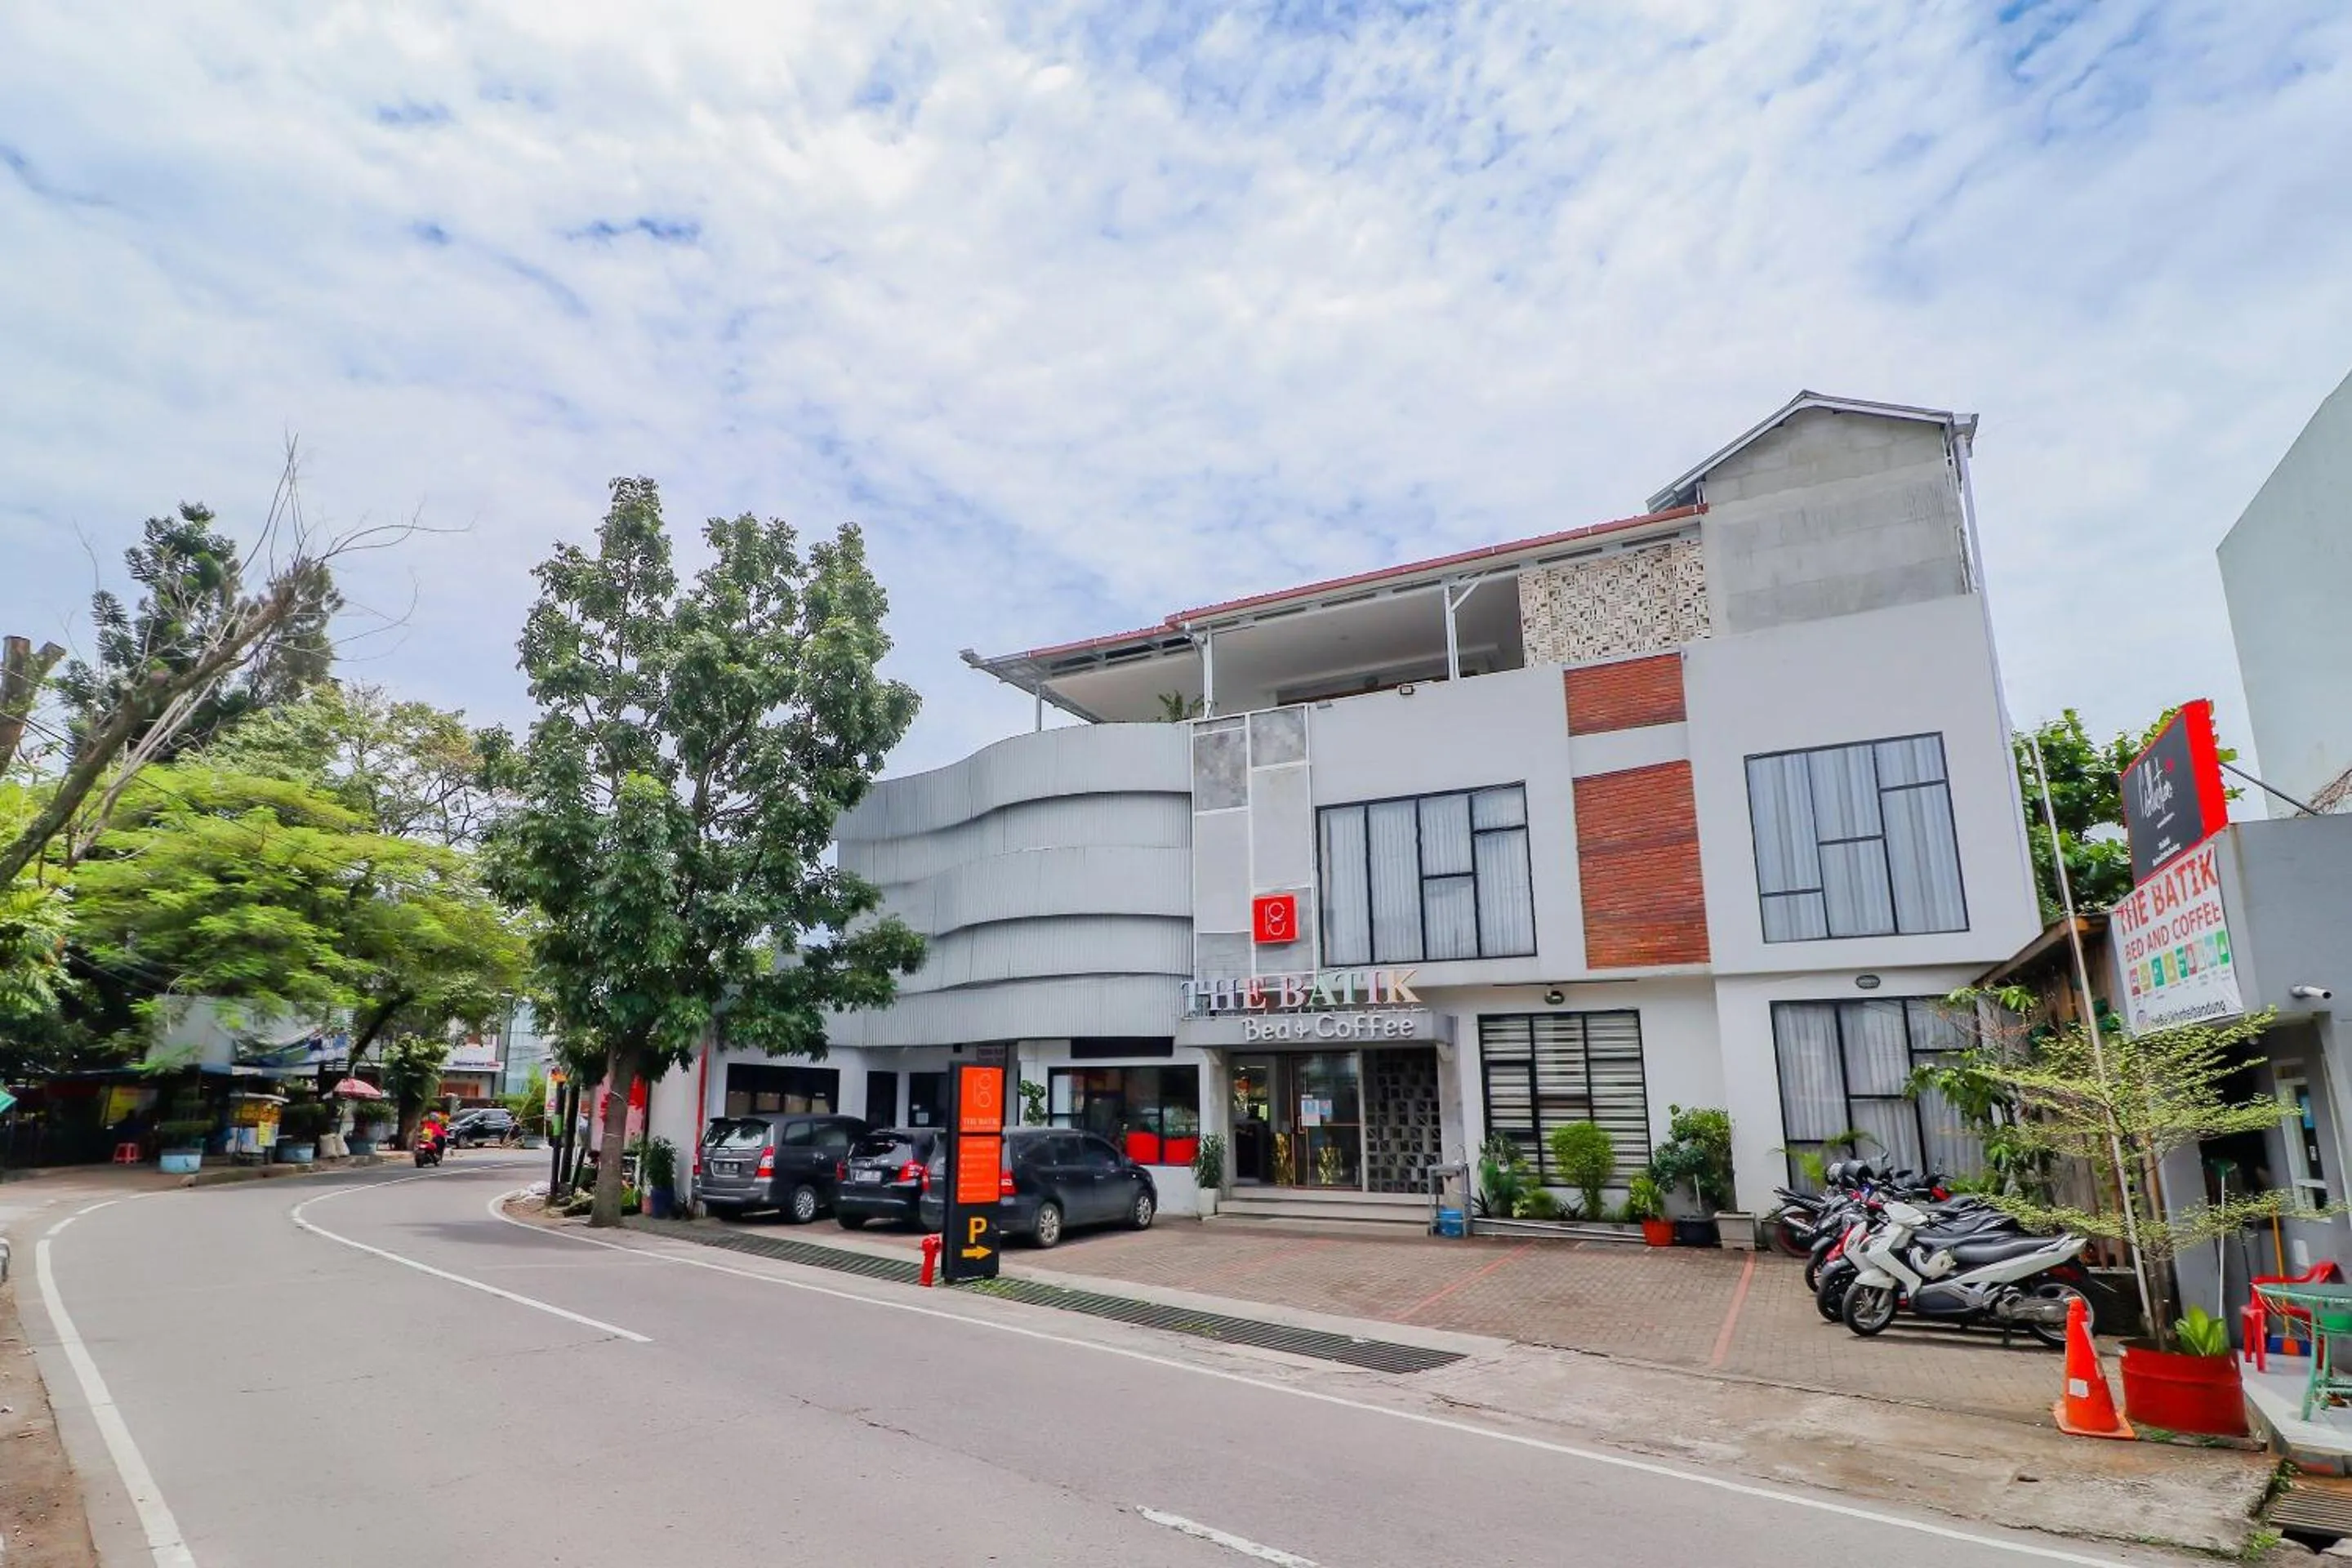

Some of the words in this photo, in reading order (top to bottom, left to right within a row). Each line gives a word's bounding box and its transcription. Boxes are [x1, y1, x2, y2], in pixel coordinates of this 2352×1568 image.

[2114, 889, 2149, 935] THE
[2151, 848, 2218, 916] BATIK
[2125, 938, 2145, 962] BED
[2147, 924, 2169, 953] AND
[2172, 901, 2221, 940] COFFEE
[1181, 978, 1267, 1012] THE
[1276, 969, 1422, 1009] BATIK
[1242, 1018, 1290, 1042] Bed
[1294, 1019, 1311, 1040] &
[1315, 1014, 1415, 1039] Coffee
[969, 1216, 988, 1245] P
